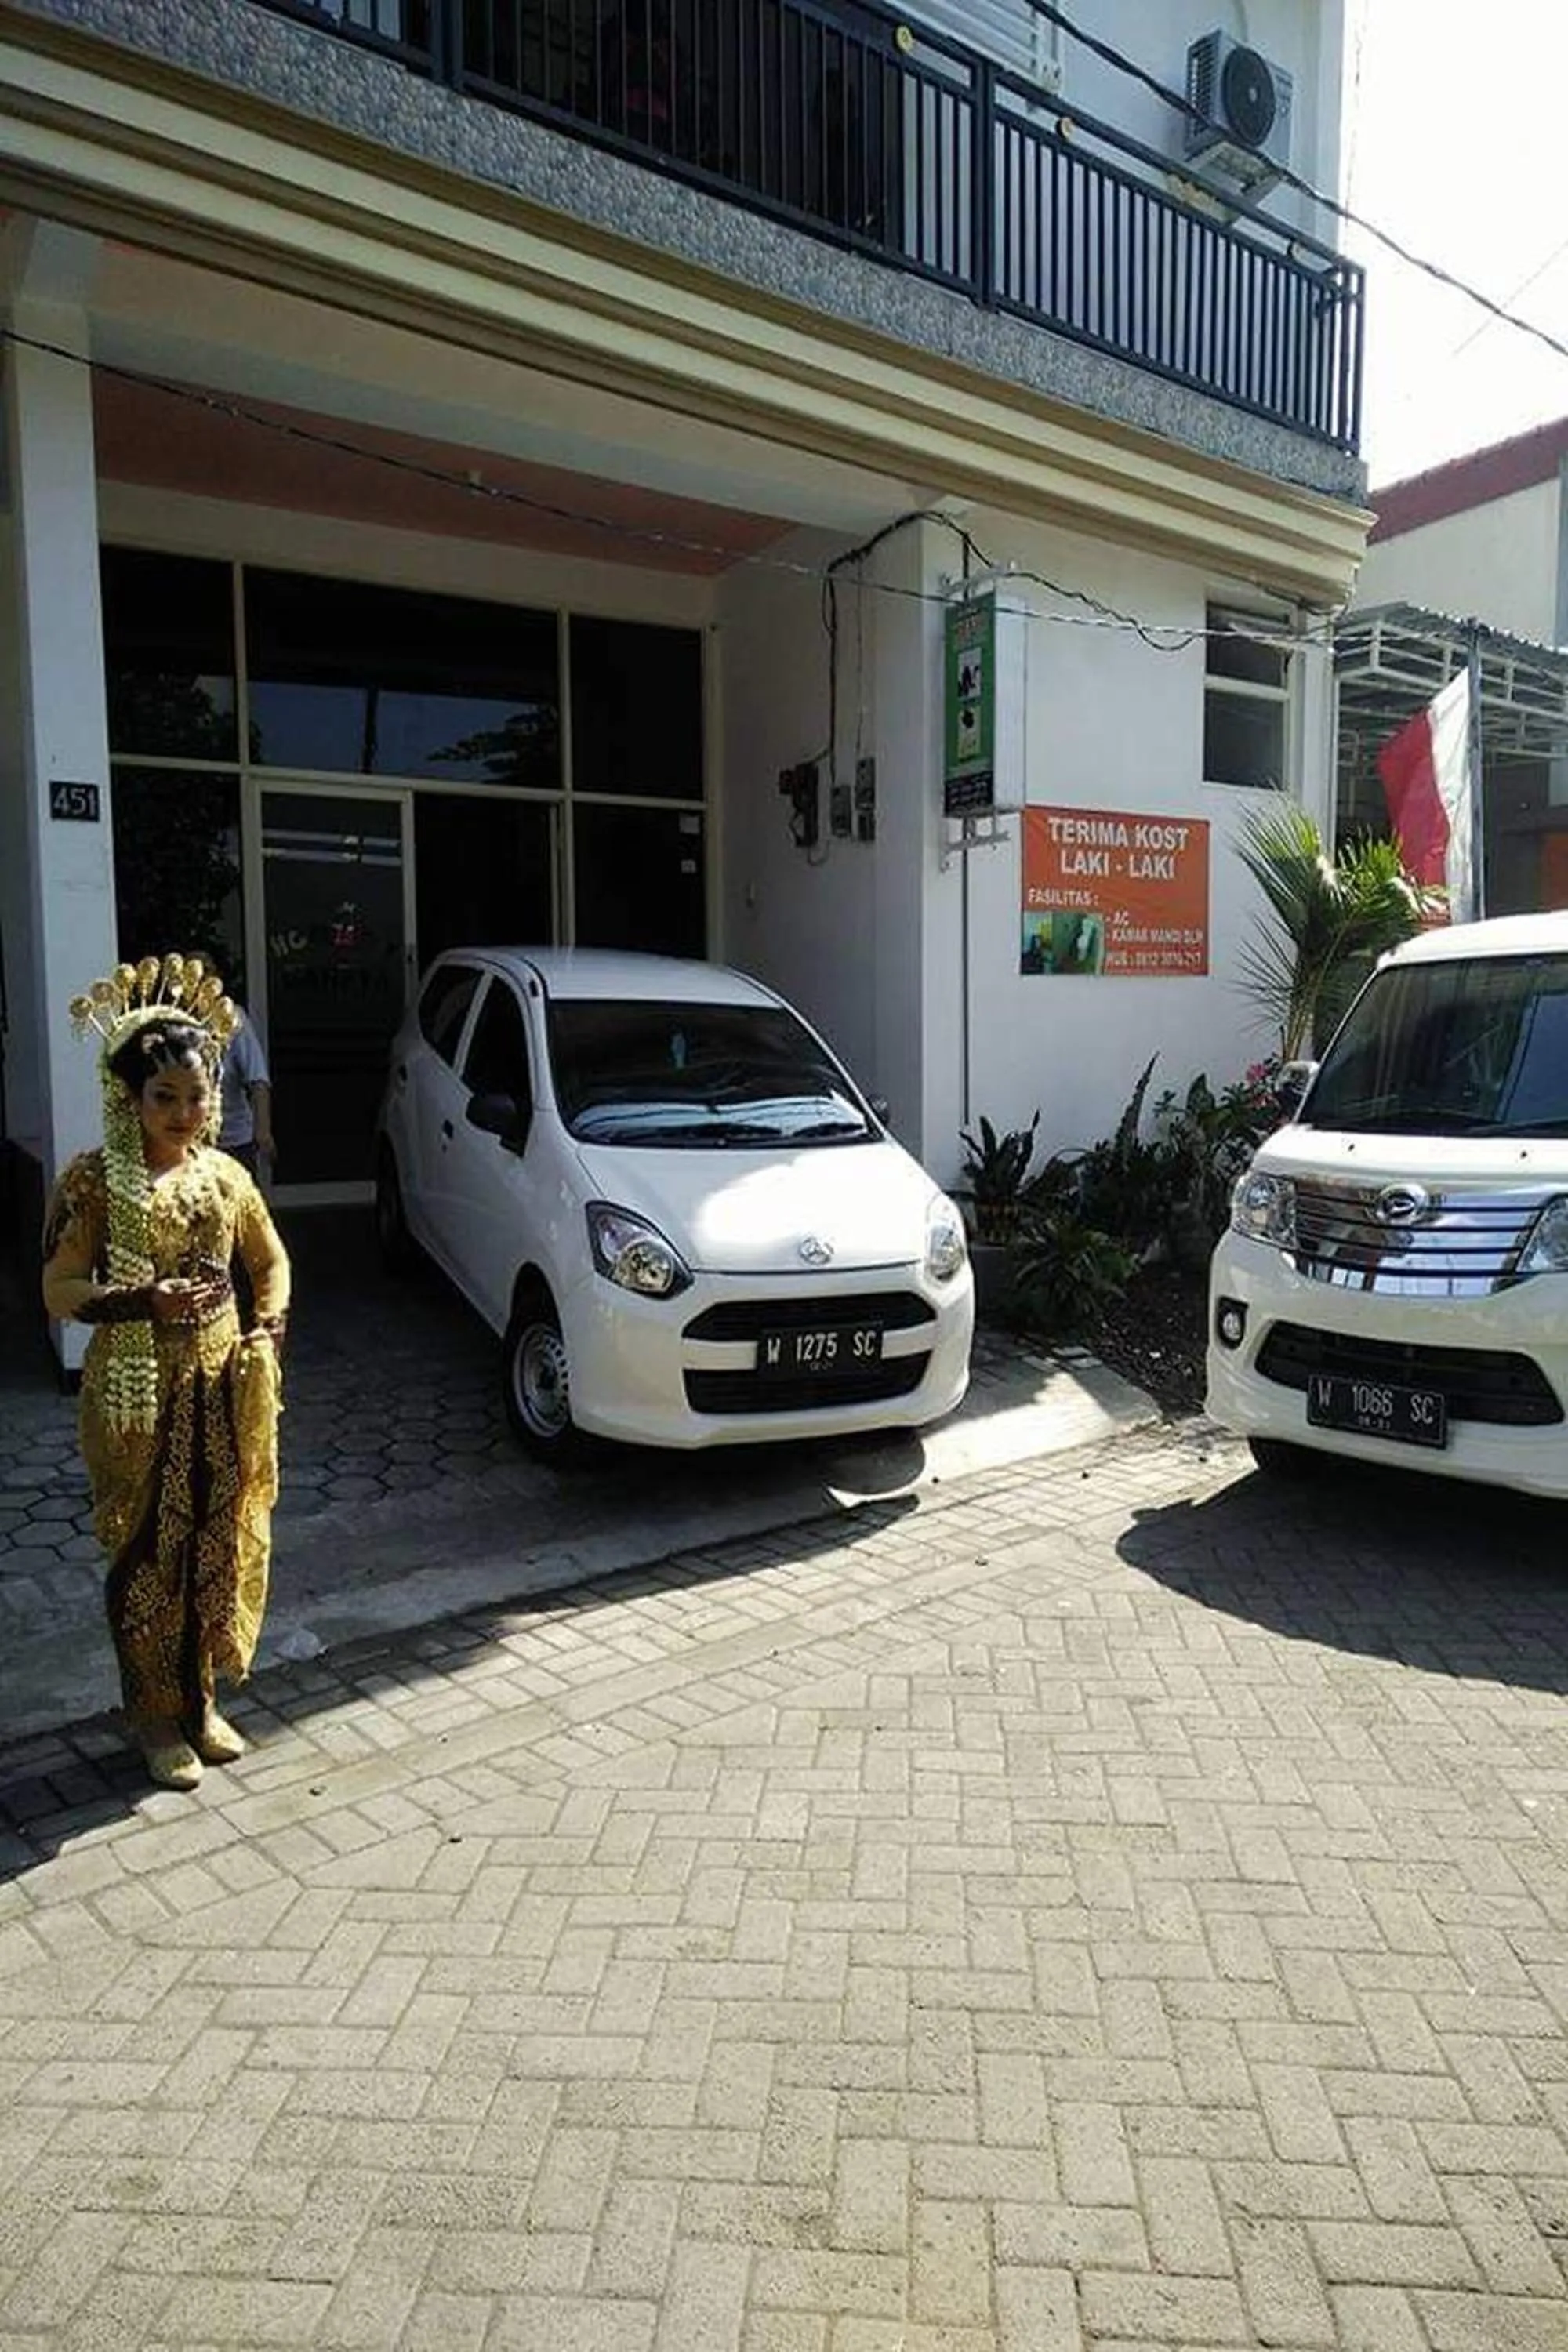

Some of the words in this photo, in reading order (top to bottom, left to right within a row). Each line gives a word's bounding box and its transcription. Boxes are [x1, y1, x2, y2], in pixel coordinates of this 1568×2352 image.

[53, 787, 96, 816] 451
[1047, 817, 1128, 847] TERIMA
[1135, 825, 1189, 850] KOST
[1061, 849, 1109, 876] LAKI
[1129, 854, 1175, 879] LAKI
[1028, 887, 1091, 906] FASILITAS
[768, 1338, 781, 1364] W
[796, 1331, 839, 1362] 1275
[852, 1330, 877, 1357] SC
[1318, 1378, 1332, 1406] W
[1410, 1393, 1434, 1425] SC
